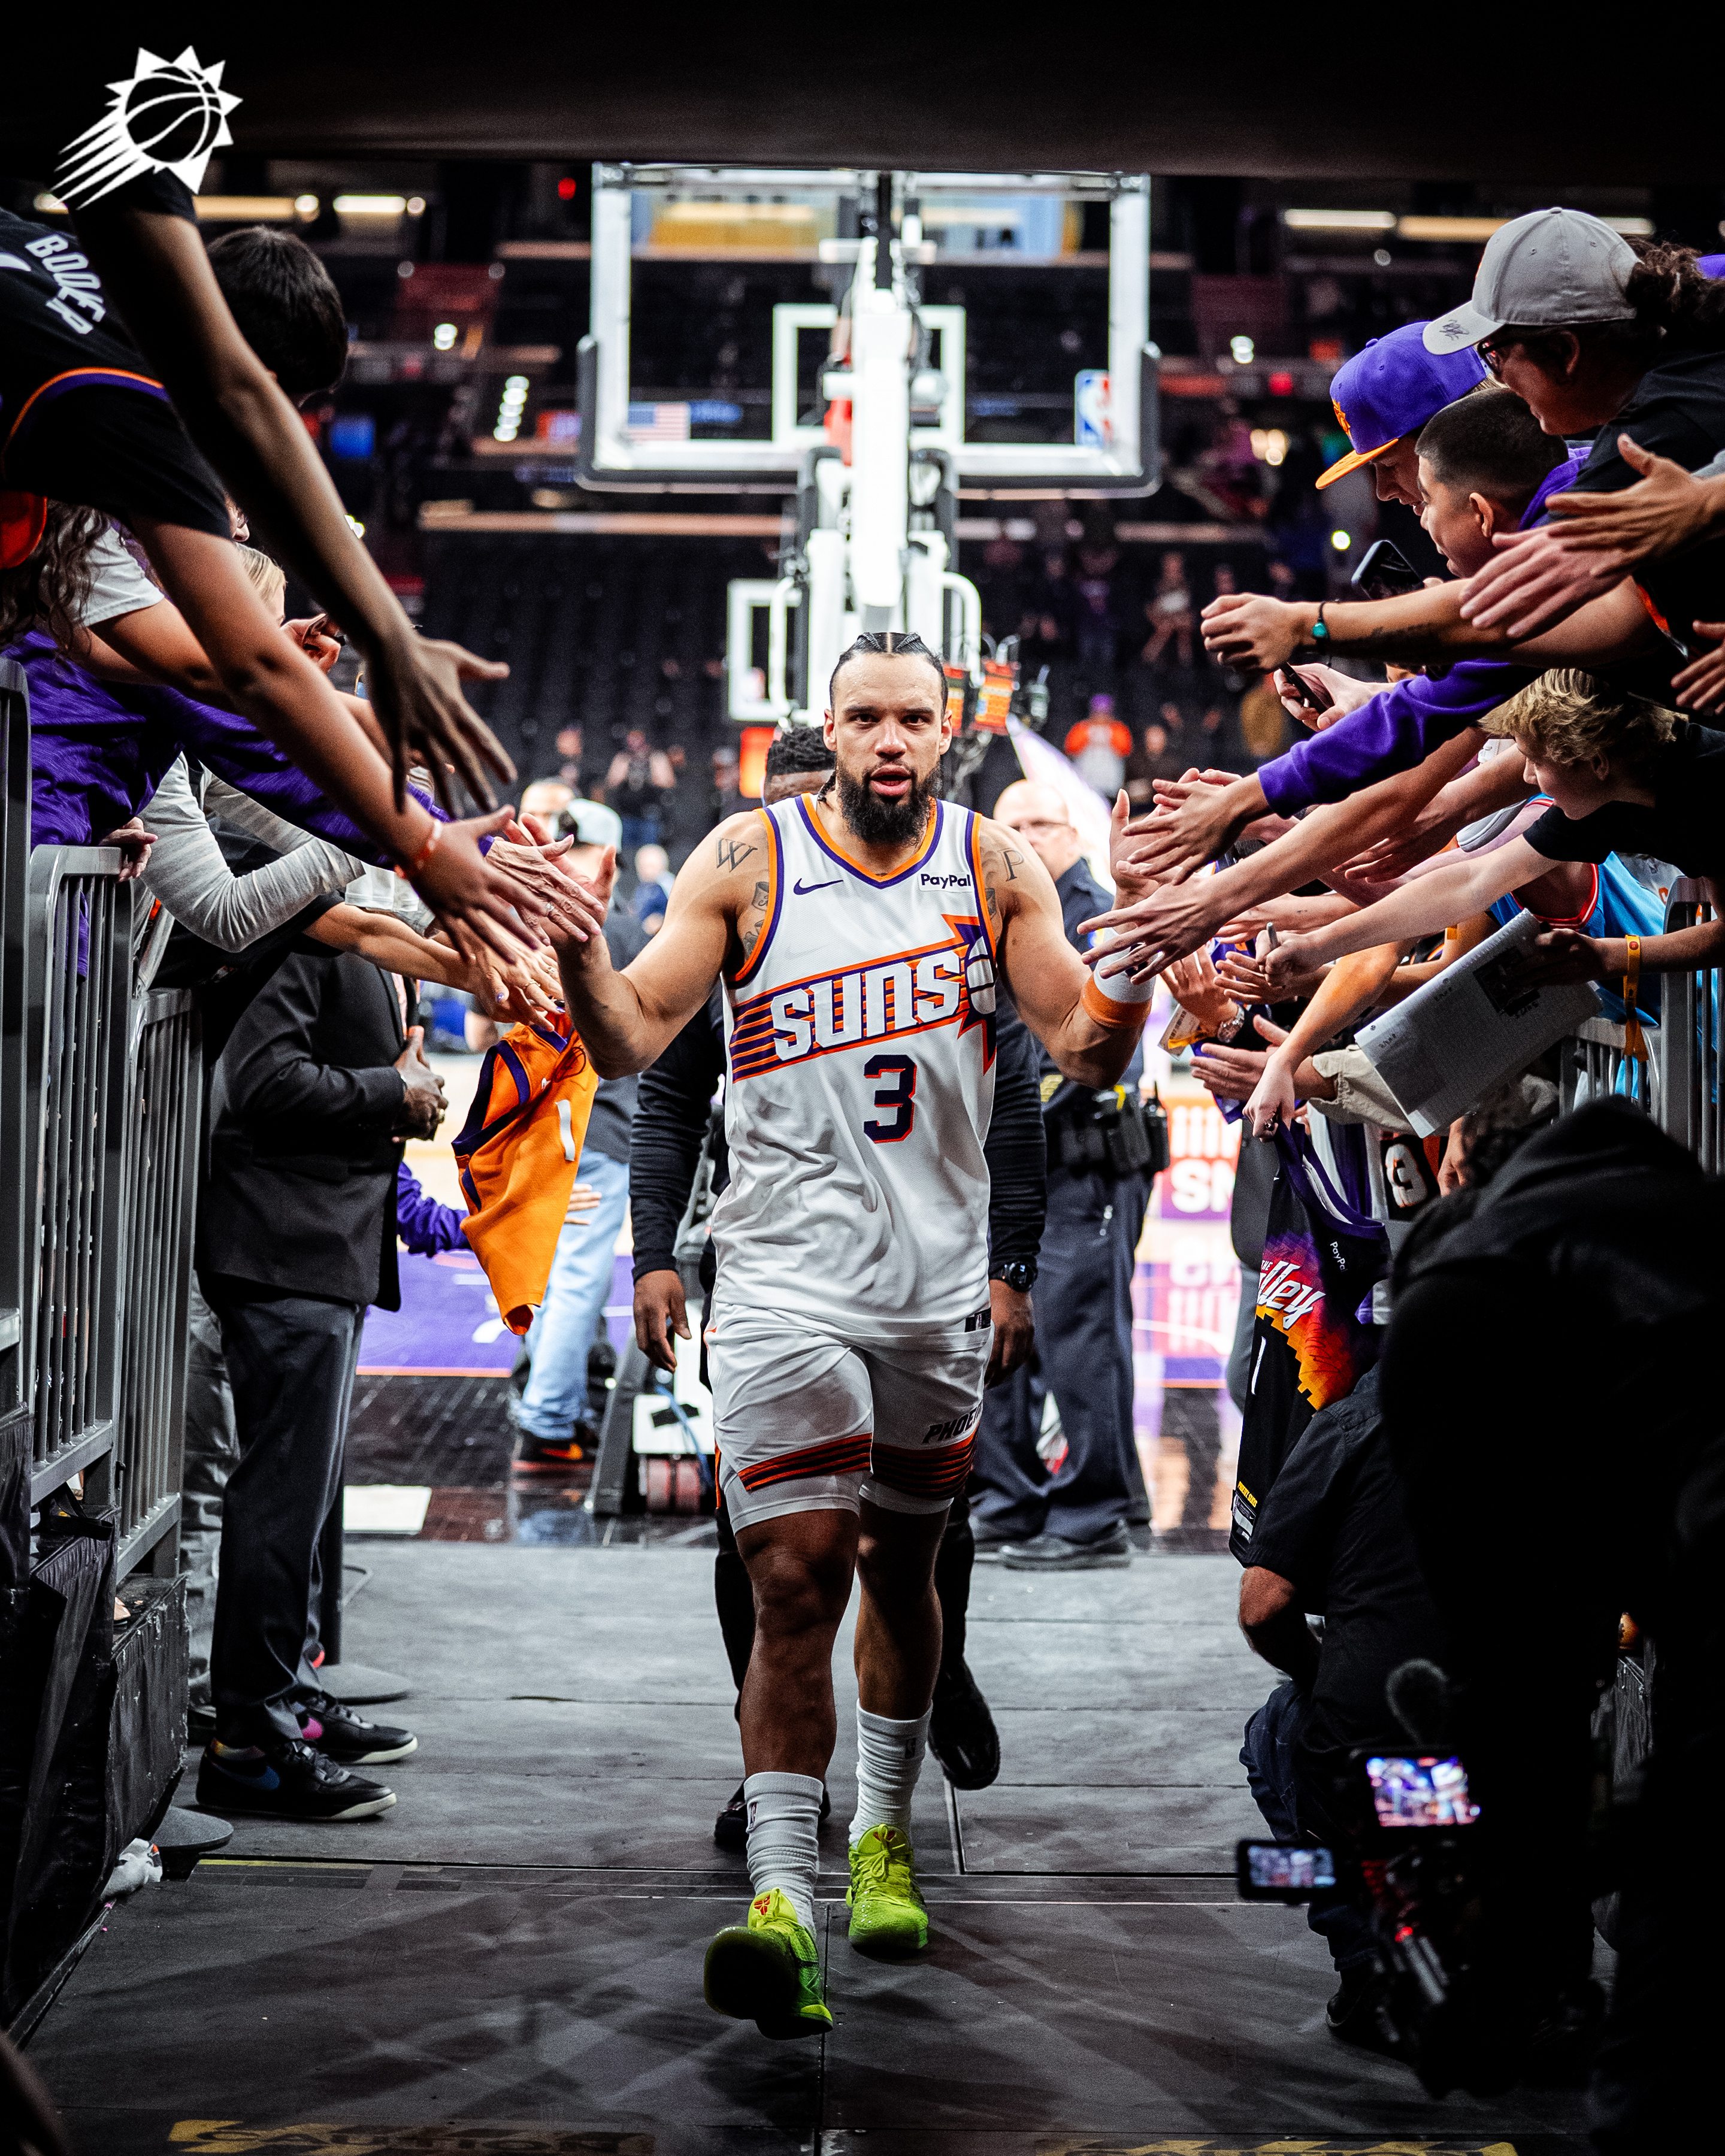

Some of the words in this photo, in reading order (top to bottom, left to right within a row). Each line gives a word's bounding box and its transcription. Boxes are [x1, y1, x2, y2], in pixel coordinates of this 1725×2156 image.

[716, 837, 758, 873] W
[997, 847, 1024, 882] P
[921, 874, 971, 889] PayPal
[771, 950, 961, 1061] SUNS
[864, 1055, 916, 1143] 3
[1330, 1241, 1348, 1273] PayPal
[1257, 1260, 1326, 1330] lley
[922, 1400, 983, 1444] PHOE
